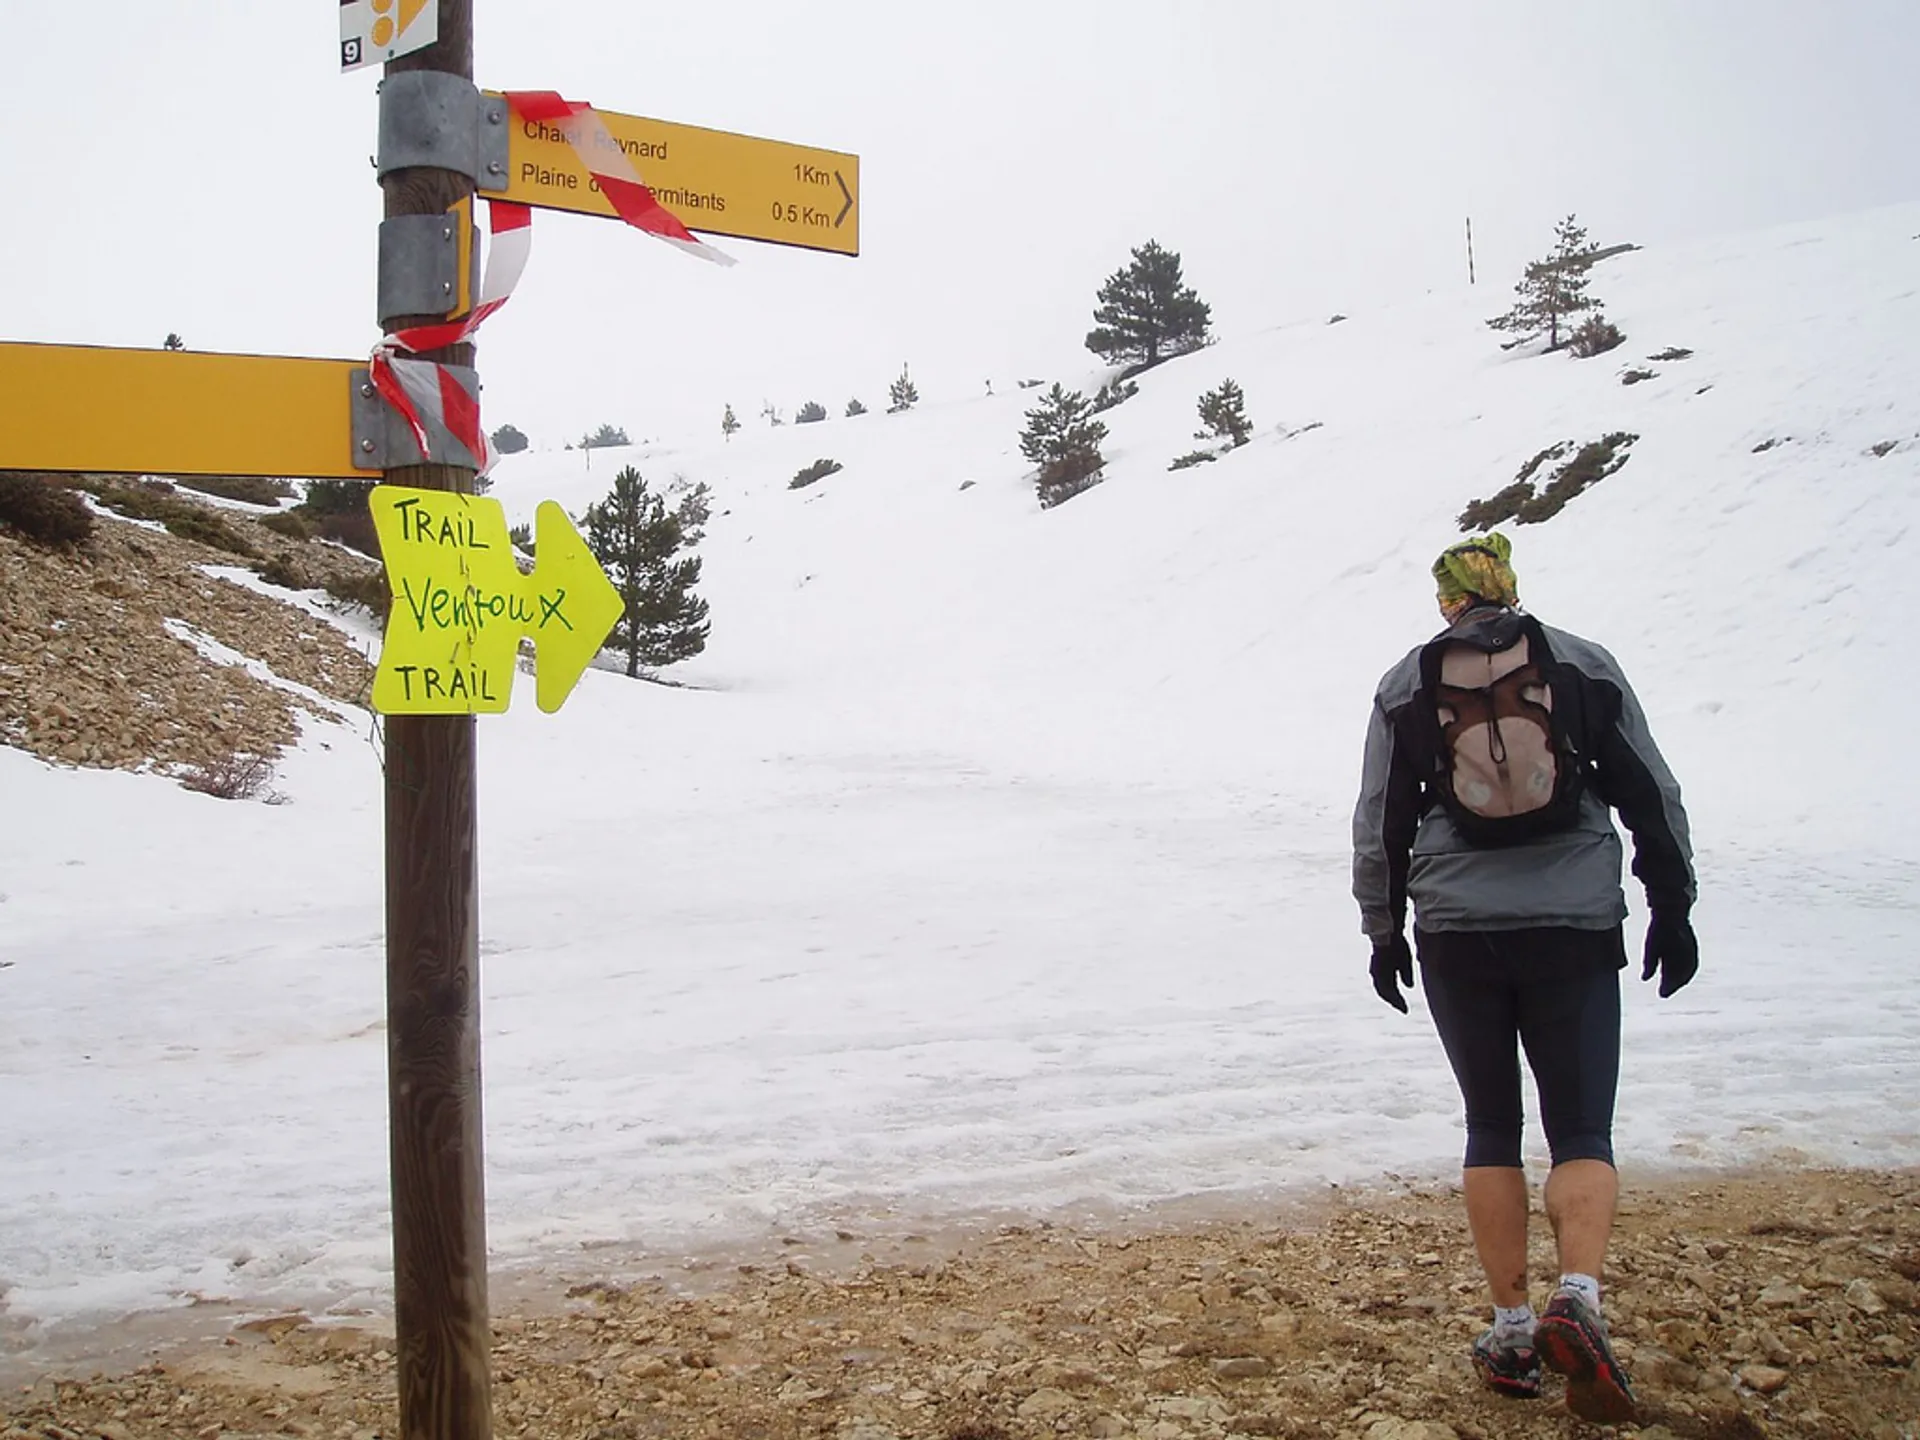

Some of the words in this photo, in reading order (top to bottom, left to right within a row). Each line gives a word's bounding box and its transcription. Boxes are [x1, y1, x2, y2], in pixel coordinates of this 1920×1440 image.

[344, 41, 358, 63] 9
[521, 163, 577, 189] Plaine
[644, 181, 725, 212] ermitants
[772, 201, 798, 223] 0.5
[802, 207, 830, 228] Km
